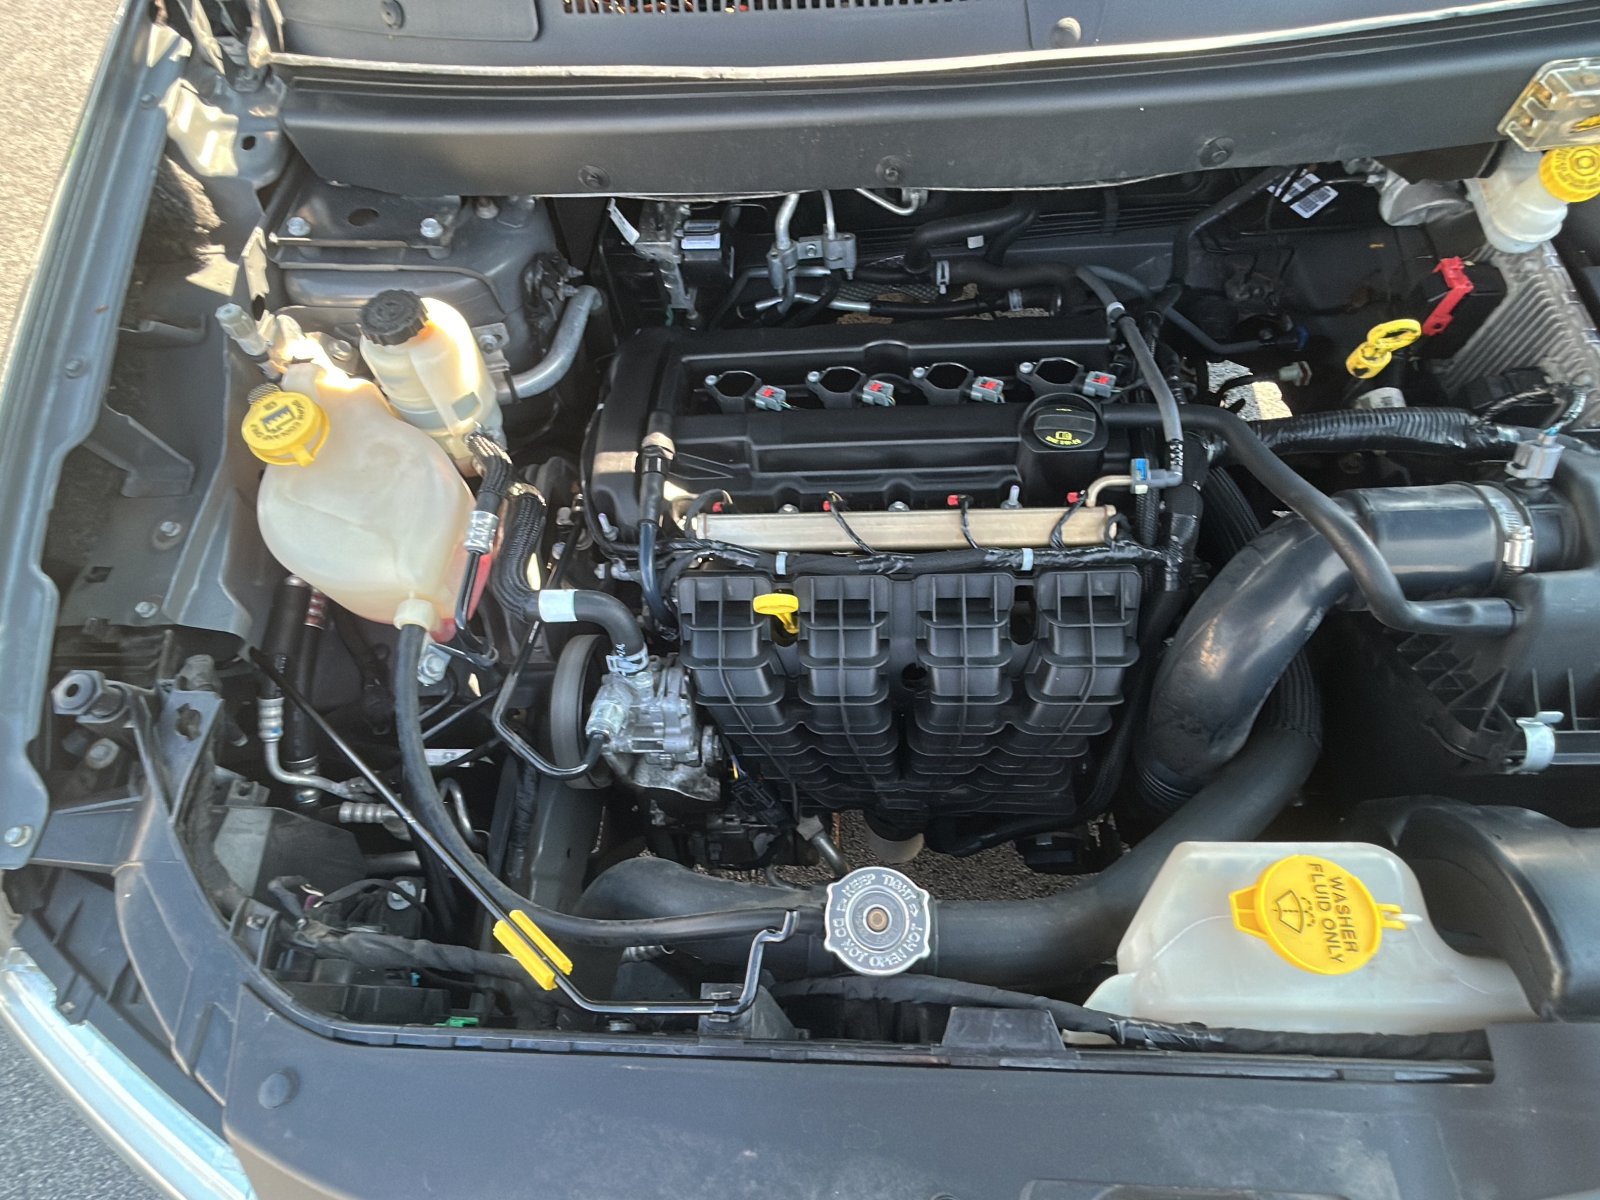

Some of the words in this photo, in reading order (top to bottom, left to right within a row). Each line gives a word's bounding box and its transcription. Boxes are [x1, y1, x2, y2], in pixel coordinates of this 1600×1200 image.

[842, 873, 876, 897] KEEP
[883, 873, 917, 900] TIGHT
[1307, 862, 1332, 913] FLUID
[1328, 876, 1359, 953] WASHER
[833, 918, 847, 938] DO
[841, 940, 869, 963] NOT
[868, 947, 908, 968] OPEN
[904, 922, 924, 953] HOT
[1319, 916, 1345, 964] ONLY
